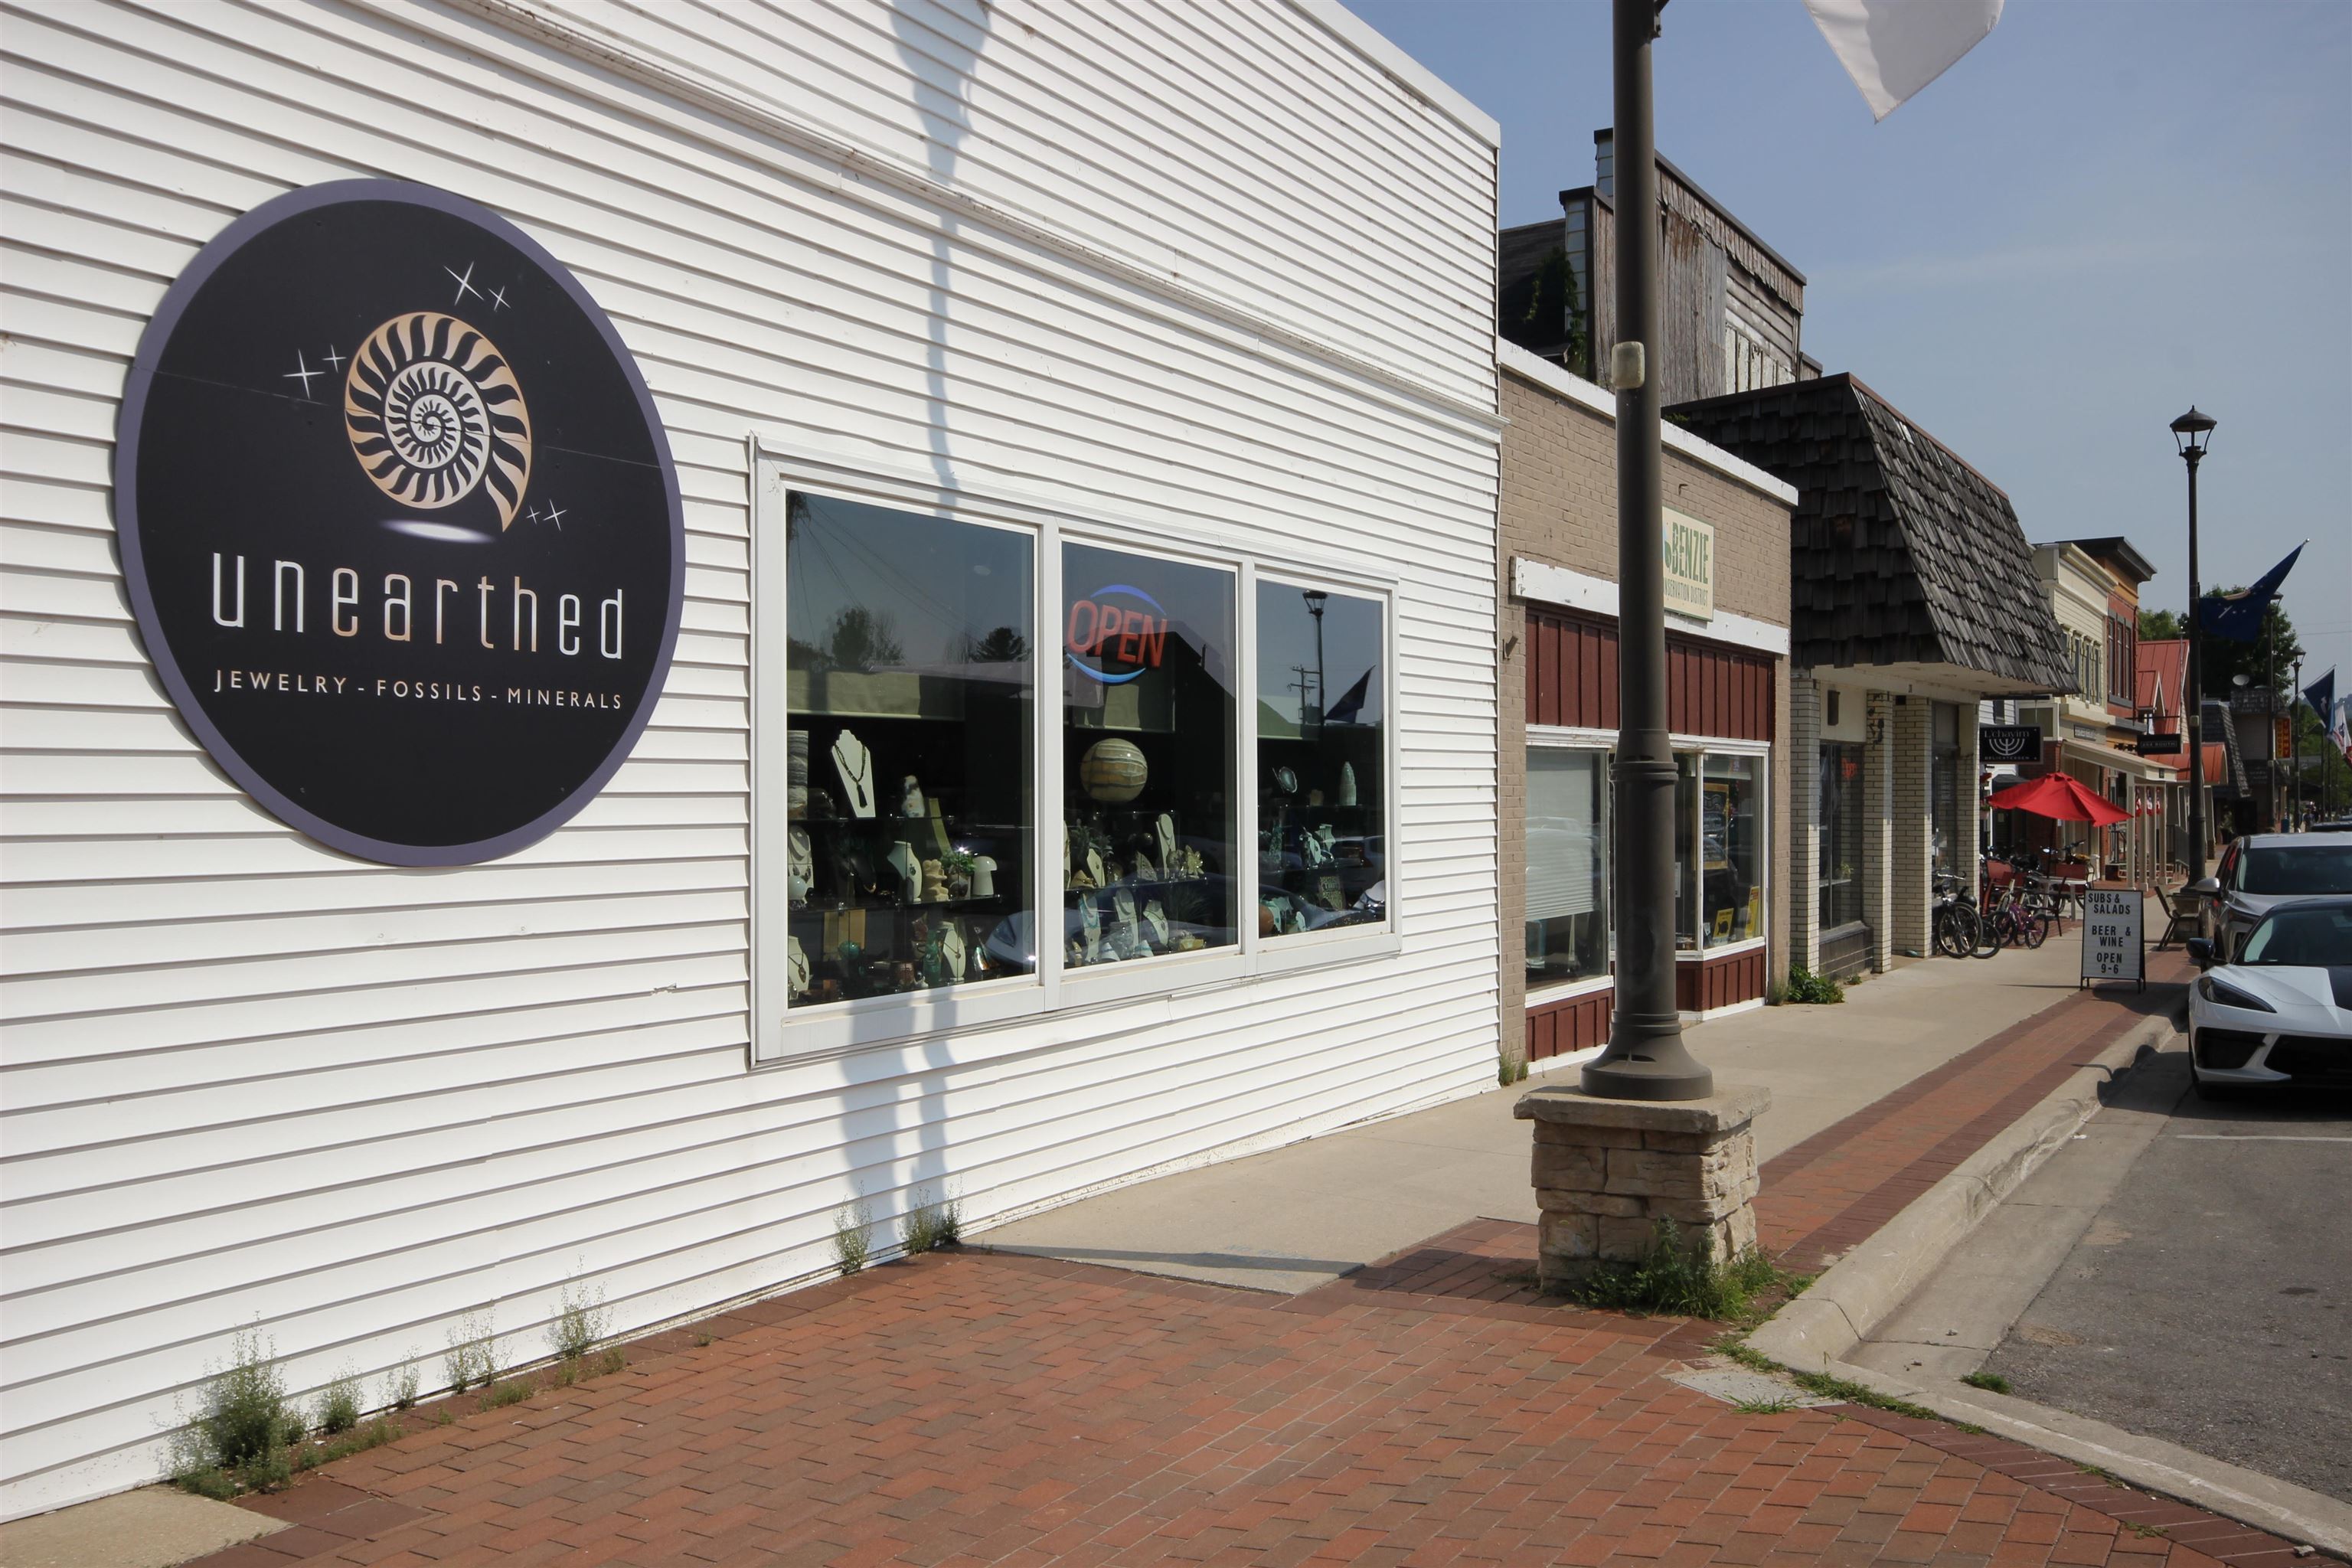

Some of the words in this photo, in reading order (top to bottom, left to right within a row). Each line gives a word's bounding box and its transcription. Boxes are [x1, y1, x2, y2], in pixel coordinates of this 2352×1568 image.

[1671, 521, 1709, 585] BENZIE
[1664, 577, 1689, 602] NSERVATION
[212, 552, 622, 659] unearthed
[1067, 599, 1168, 668] OPEN
[214, 669, 347, 694] JEWELRY
[377, 679, 482, 702] FOSSILS
[508, 688, 622, 710] MINERALS
[2088, 893, 2112, 903] SUBS
[2114, 893, 2120, 903] &
[2093, 904, 2131, 915] SALADS
[2092, 925, 2116, 936] BEER
[2125, 926, 2131, 936] &
[2099, 936, 2123, 947] WINE
[2096, 952, 2122, 963] OPEN
[2101, 964, 2119, 974] 9-6
